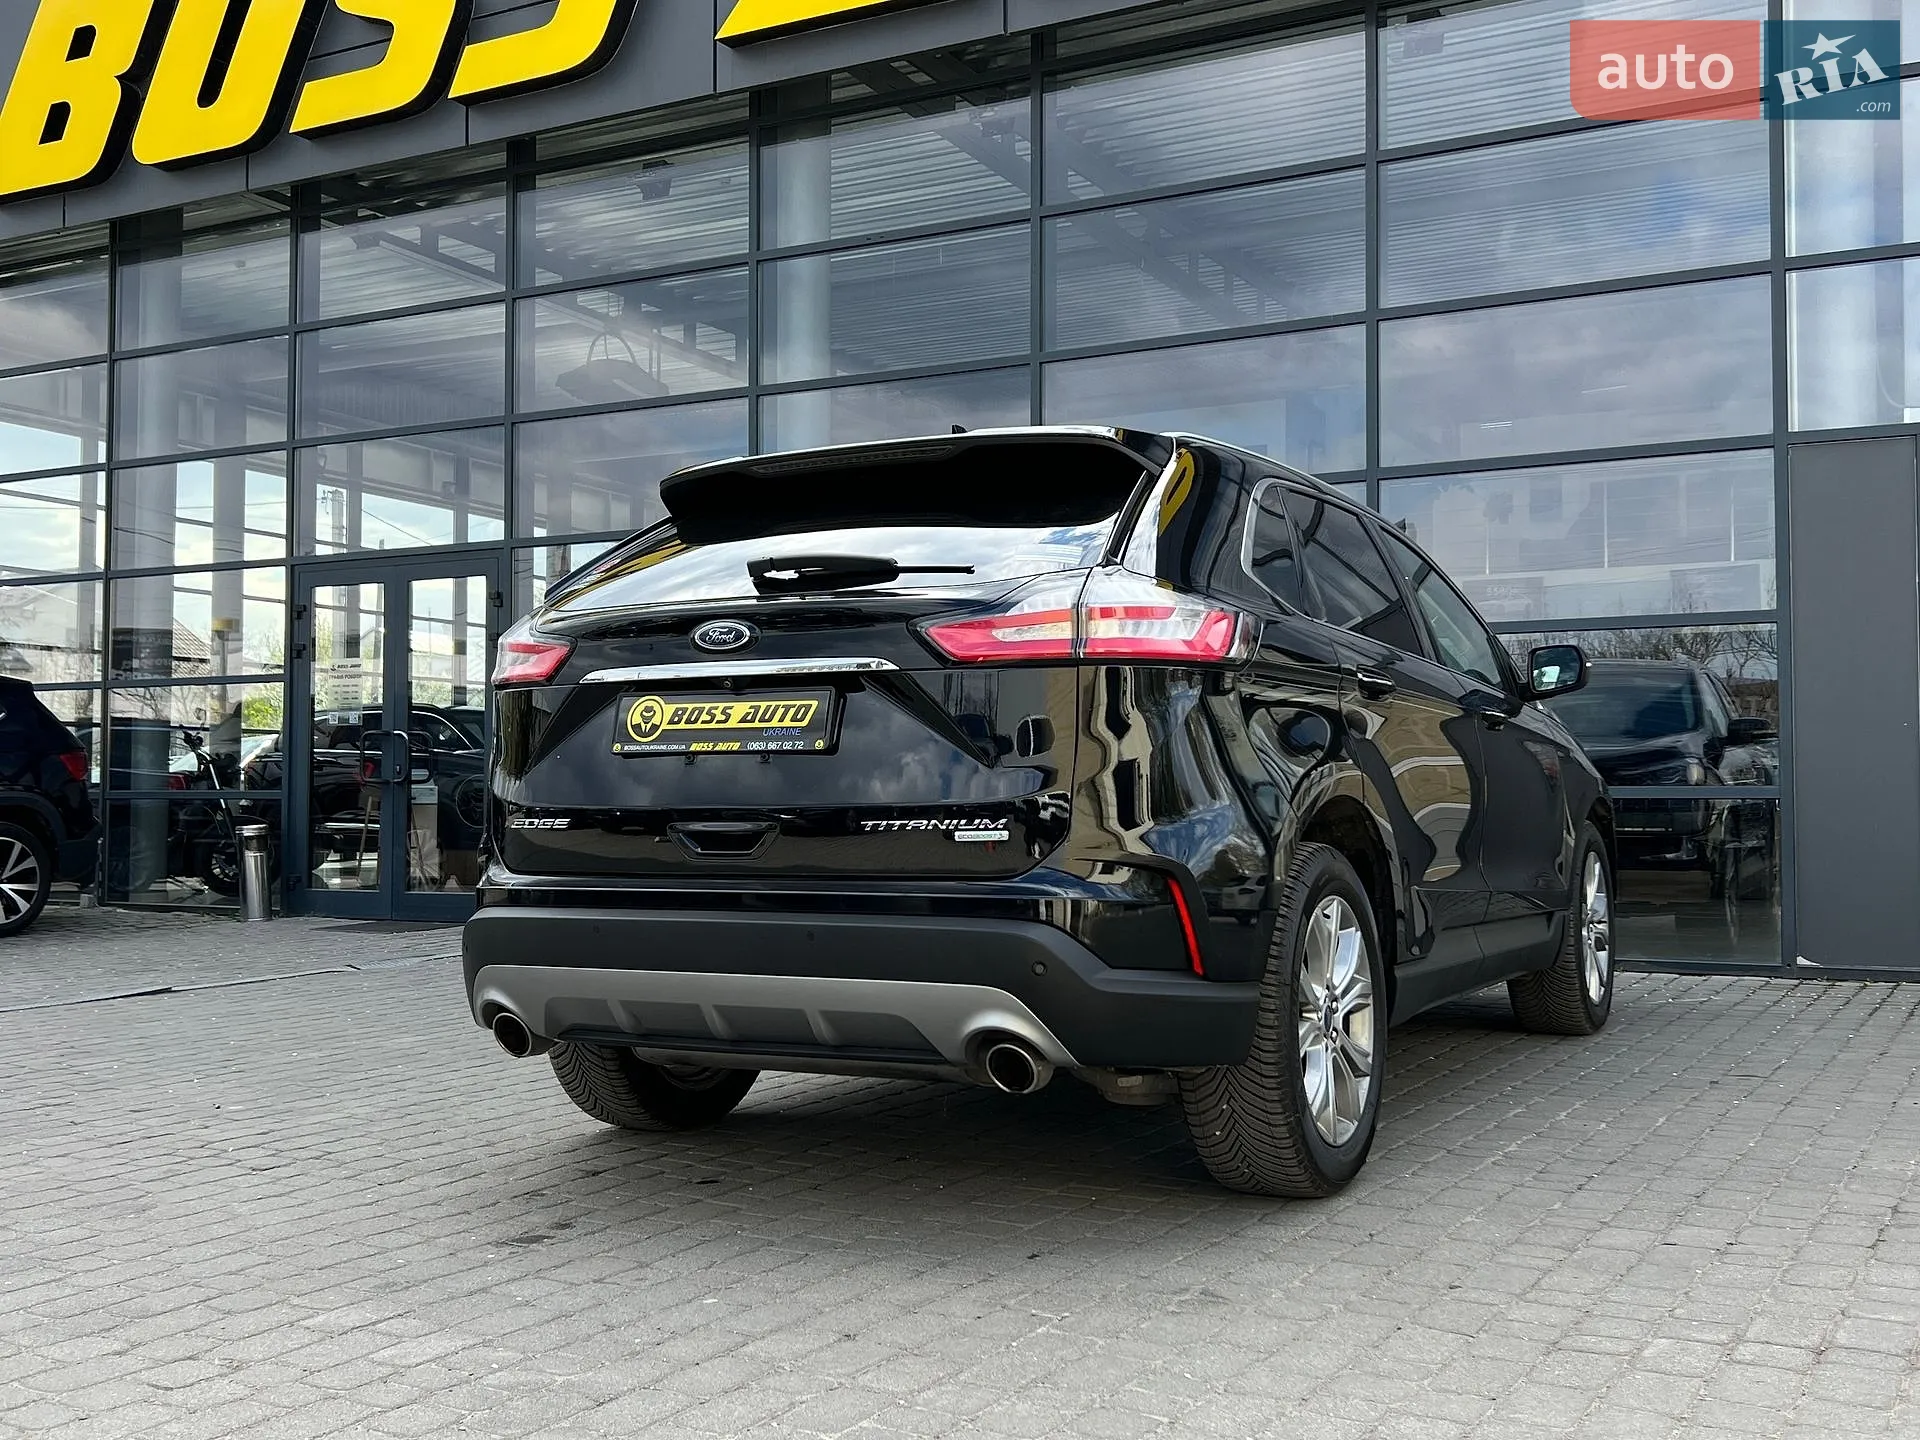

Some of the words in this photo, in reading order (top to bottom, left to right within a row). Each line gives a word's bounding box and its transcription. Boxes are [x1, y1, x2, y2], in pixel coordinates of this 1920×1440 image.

[705, 627, 736, 644] Ford
[666, 704, 735, 726] BOSS
[737, 703, 813, 724] AUTO
[762, 727, 802, 736] UKRAINE
[690, 742, 714, 751] BOSS
[714, 741, 742, 751] AUTO
[747, 741, 767, 750] (063)
[782, 741, 793, 750] 02
[794, 741, 804, 750] 72
[510, 818, 571, 829] EDGE
[860, 818, 1008, 831] TITANIUM
